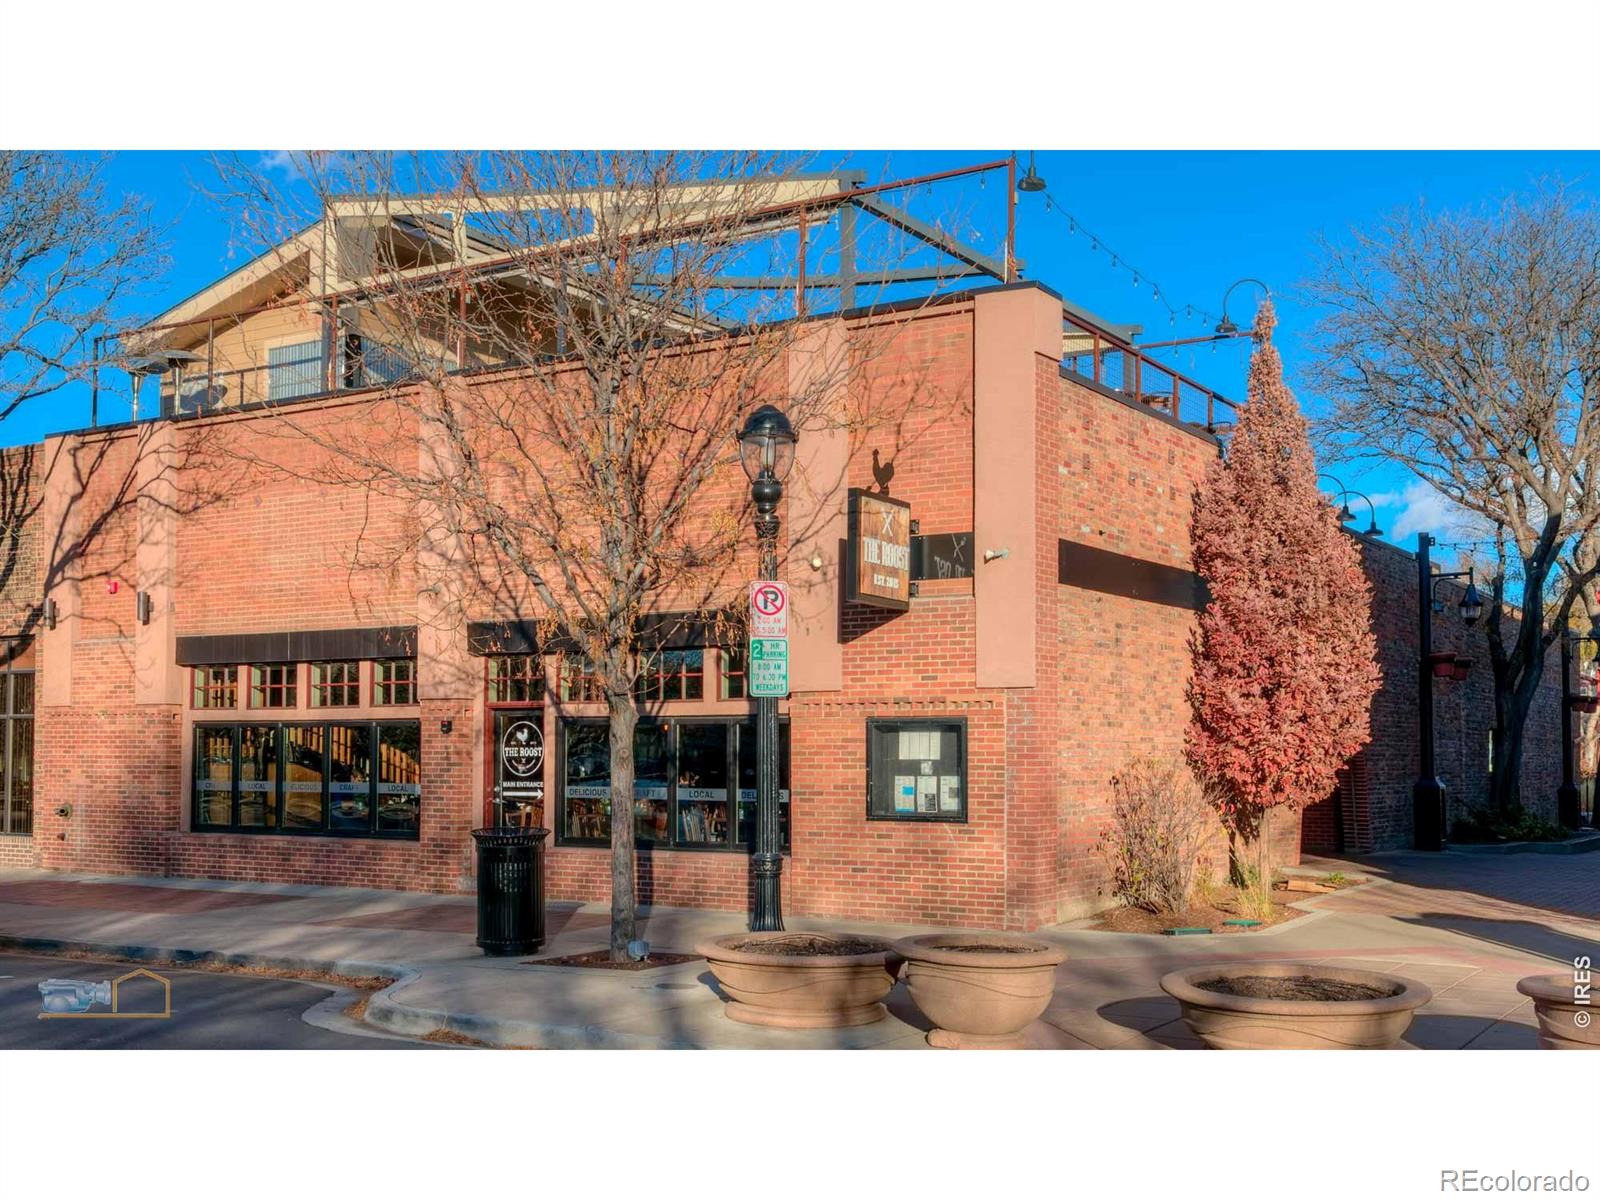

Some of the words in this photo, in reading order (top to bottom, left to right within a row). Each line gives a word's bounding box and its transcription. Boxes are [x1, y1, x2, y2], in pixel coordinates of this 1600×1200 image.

[863, 537, 881, 564] THE
[881, 541, 910, 571] ROOST
[753, 643, 761, 658] 2
[770, 642, 780, 650] HR
[774, 662, 782, 670] AM
[778, 673, 786, 681] PM
[756, 683, 784, 691] WEEKDAYS
[504, 747, 519, 757] THE
[520, 747, 543, 757] ROOST
[569, 788, 607, 796] DELICIOUS
[689, 790, 715, 798] LOCAL
